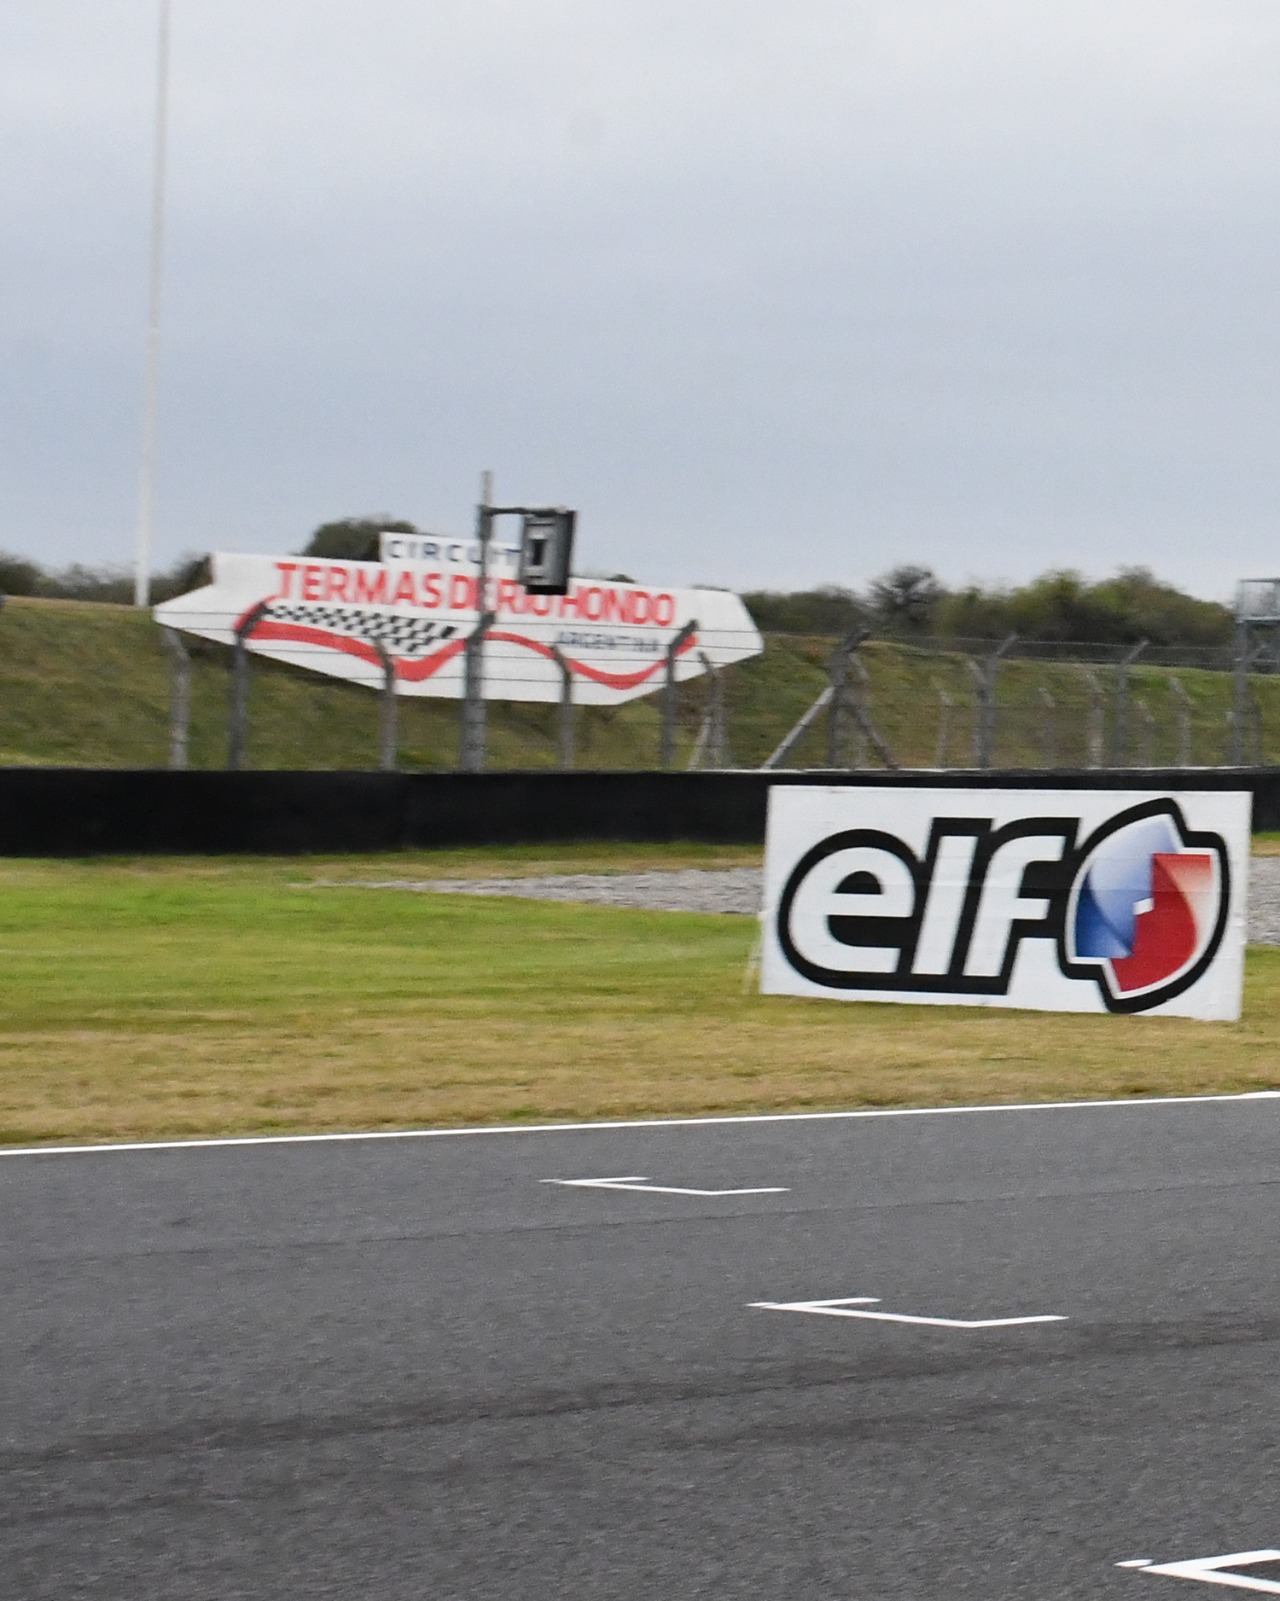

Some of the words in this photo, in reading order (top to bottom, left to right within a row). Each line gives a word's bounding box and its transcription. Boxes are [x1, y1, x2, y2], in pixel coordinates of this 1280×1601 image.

[274, 562, 441, 609] TERMAS
[557, 585, 676, 627] HONDO
[778, 817, 1080, 995] elf
